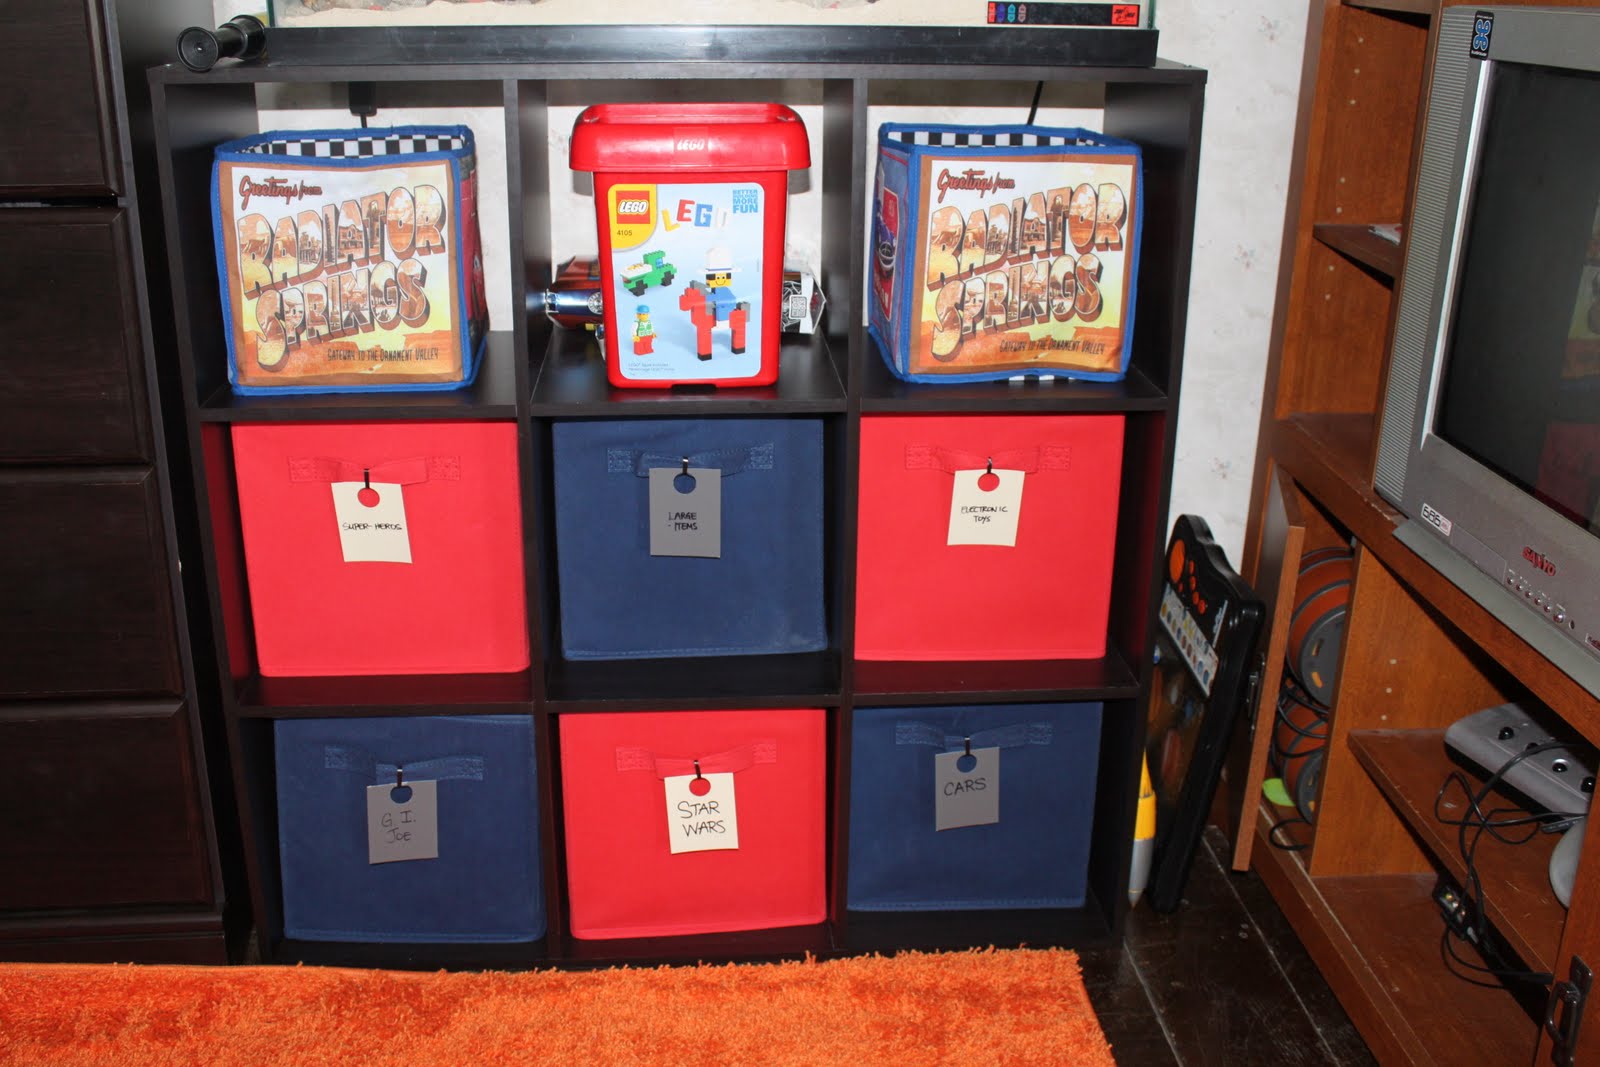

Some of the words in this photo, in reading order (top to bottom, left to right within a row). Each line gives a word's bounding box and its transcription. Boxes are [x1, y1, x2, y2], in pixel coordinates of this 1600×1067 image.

[677, 139, 705, 151] LEGO
[238, 175, 299, 211] Greetings
[298, 180, 323, 201] from
[937, 168, 993, 204] Greetings
[992, 171, 1016, 194] from
[618, 199, 648, 215] LEGO
[733, 204, 758, 213] FUN
[237, 185, 446, 300] RADIATOR
[927, 183, 1127, 291] RADIATOR
[256, 258, 430, 373] SPRINGS
[931, 253, 1104, 363] SPRINGS
[328, 348, 355, 361] GATEWAY
[367, 349, 378, 360] THE
[380, 348, 413, 361] ORNAMENT
[415, 347, 439, 360] VALLEY
[1047, 339, 1080, 352] ORNAMENT
[1081, 340, 1105, 354] VALLEY
[668, 512, 697, 520] LARGE
[974, 515, 991, 524] TOYS
[1523, 546, 1556, 576] SANYO
[943, 777, 987, 796] CARS
[677, 800, 720, 819] STAR
[682, 820, 726, 837] WARS
